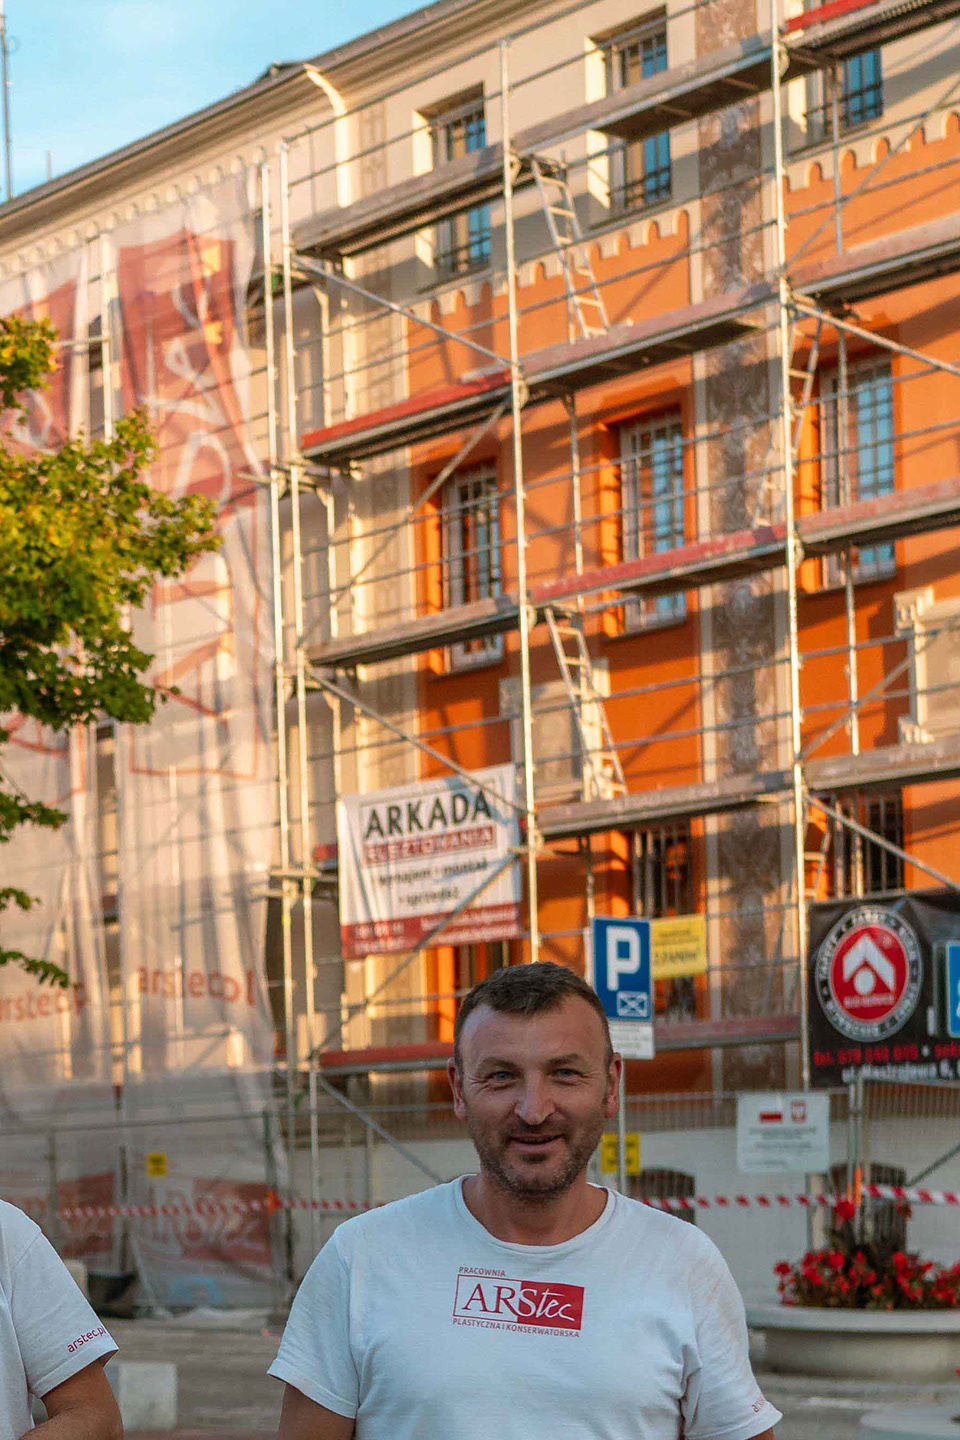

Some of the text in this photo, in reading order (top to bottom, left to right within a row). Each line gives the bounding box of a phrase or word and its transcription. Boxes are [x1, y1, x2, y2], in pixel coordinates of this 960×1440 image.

[365, 789, 492, 839] ARKADA
[606, 925, 640, 991] P
[458, 1266, 506, 1277] PRACOWNIA
[461, 1283, 575, 1322] ARStec
[67, 1325, 107, 1353] arstec.pl
[453, 1318, 500, 1331] PLASTYCZNA
[506, 1323, 580, 1338] KONSERWATORSKA
